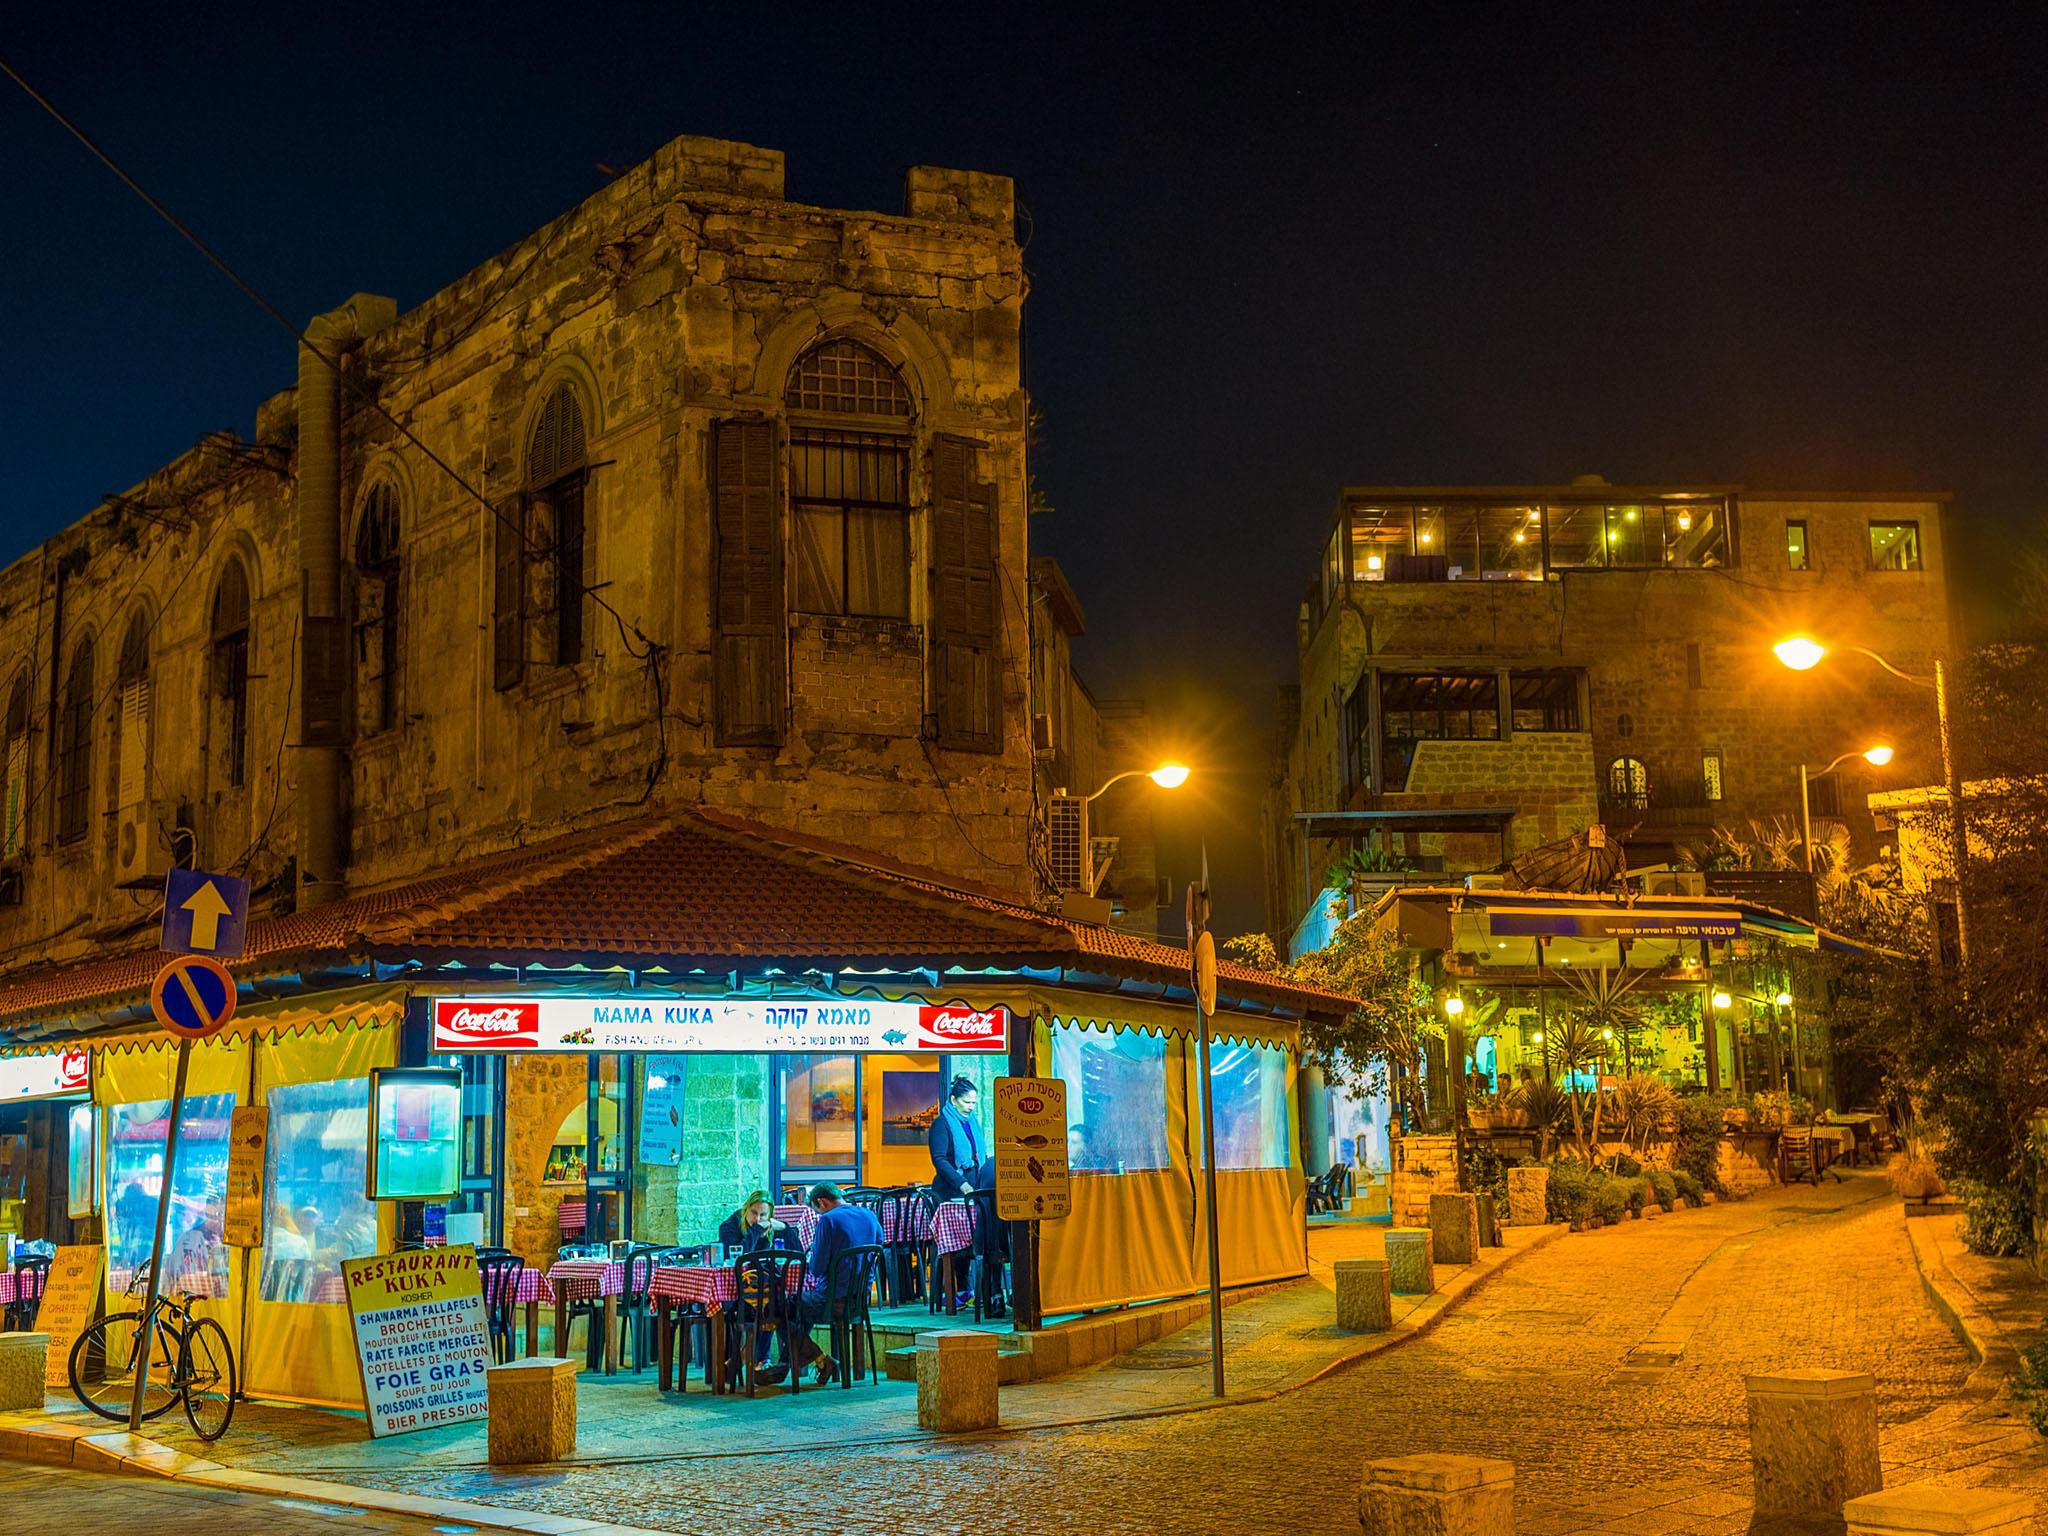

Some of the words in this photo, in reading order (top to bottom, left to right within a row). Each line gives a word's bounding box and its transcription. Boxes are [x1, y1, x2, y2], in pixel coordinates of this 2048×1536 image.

[450, 1007, 524, 1032] Coca-Cola
[593, 1007, 653, 1024] MAMA
[664, 1007, 714, 1024] KUKA
[765, 1007, 809, 1030] קוקה
[816, 1007, 871, 1026] מאמא
[932, 1010, 996, 1035] Coca-Cola
[999, 1082, 1023, 1100] קוקה
[1027, 1082, 1062, 1103] מסעדת
[1020, 1100, 1042, 1111] כשר
[999, 1107, 1018, 1125] KUKA
[1019, 1109, 1063, 1128] RESTAURANT
[351, 1254, 474, 1287] RESTAURANT
[385, 1271, 447, 1294] KUKA
[400, 1291, 433, 1304] KOSHER
[360, 1308, 419, 1325] SHAWARMA
[422, 1297, 479, 1321] FALLAFELS
[380, 1313, 464, 1336] BROCHETTES
[364, 1335, 399, 1349] MOUTON
[401, 1332, 420, 1343] BEUF
[422, 1329, 448, 1340] KEBAB
[366, 1346, 394, 1363] RATE
[398, 1341, 436, 1357] FARCIE
[438, 1333, 485, 1351] MERGEZ
[367, 1355, 425, 1375] COTELLETS
[429, 1354, 442, 1365] DE
[444, 1346, 489, 1362] MOUTON
[375, 1370, 422, 1391] FOIE
[429, 1359, 485, 1382] GRAS
[395, 1385, 427, 1399] SOUPE
[430, 1382, 445, 1393] DU
[447, 1378, 471, 1390] JOUR
[376, 1399, 425, 1416] POISSONS
[427, 1390, 464, 1407] GRILLES
[387, 1415, 417, 1430] BIER
[422, 1402, 488, 1424] PRESSION
